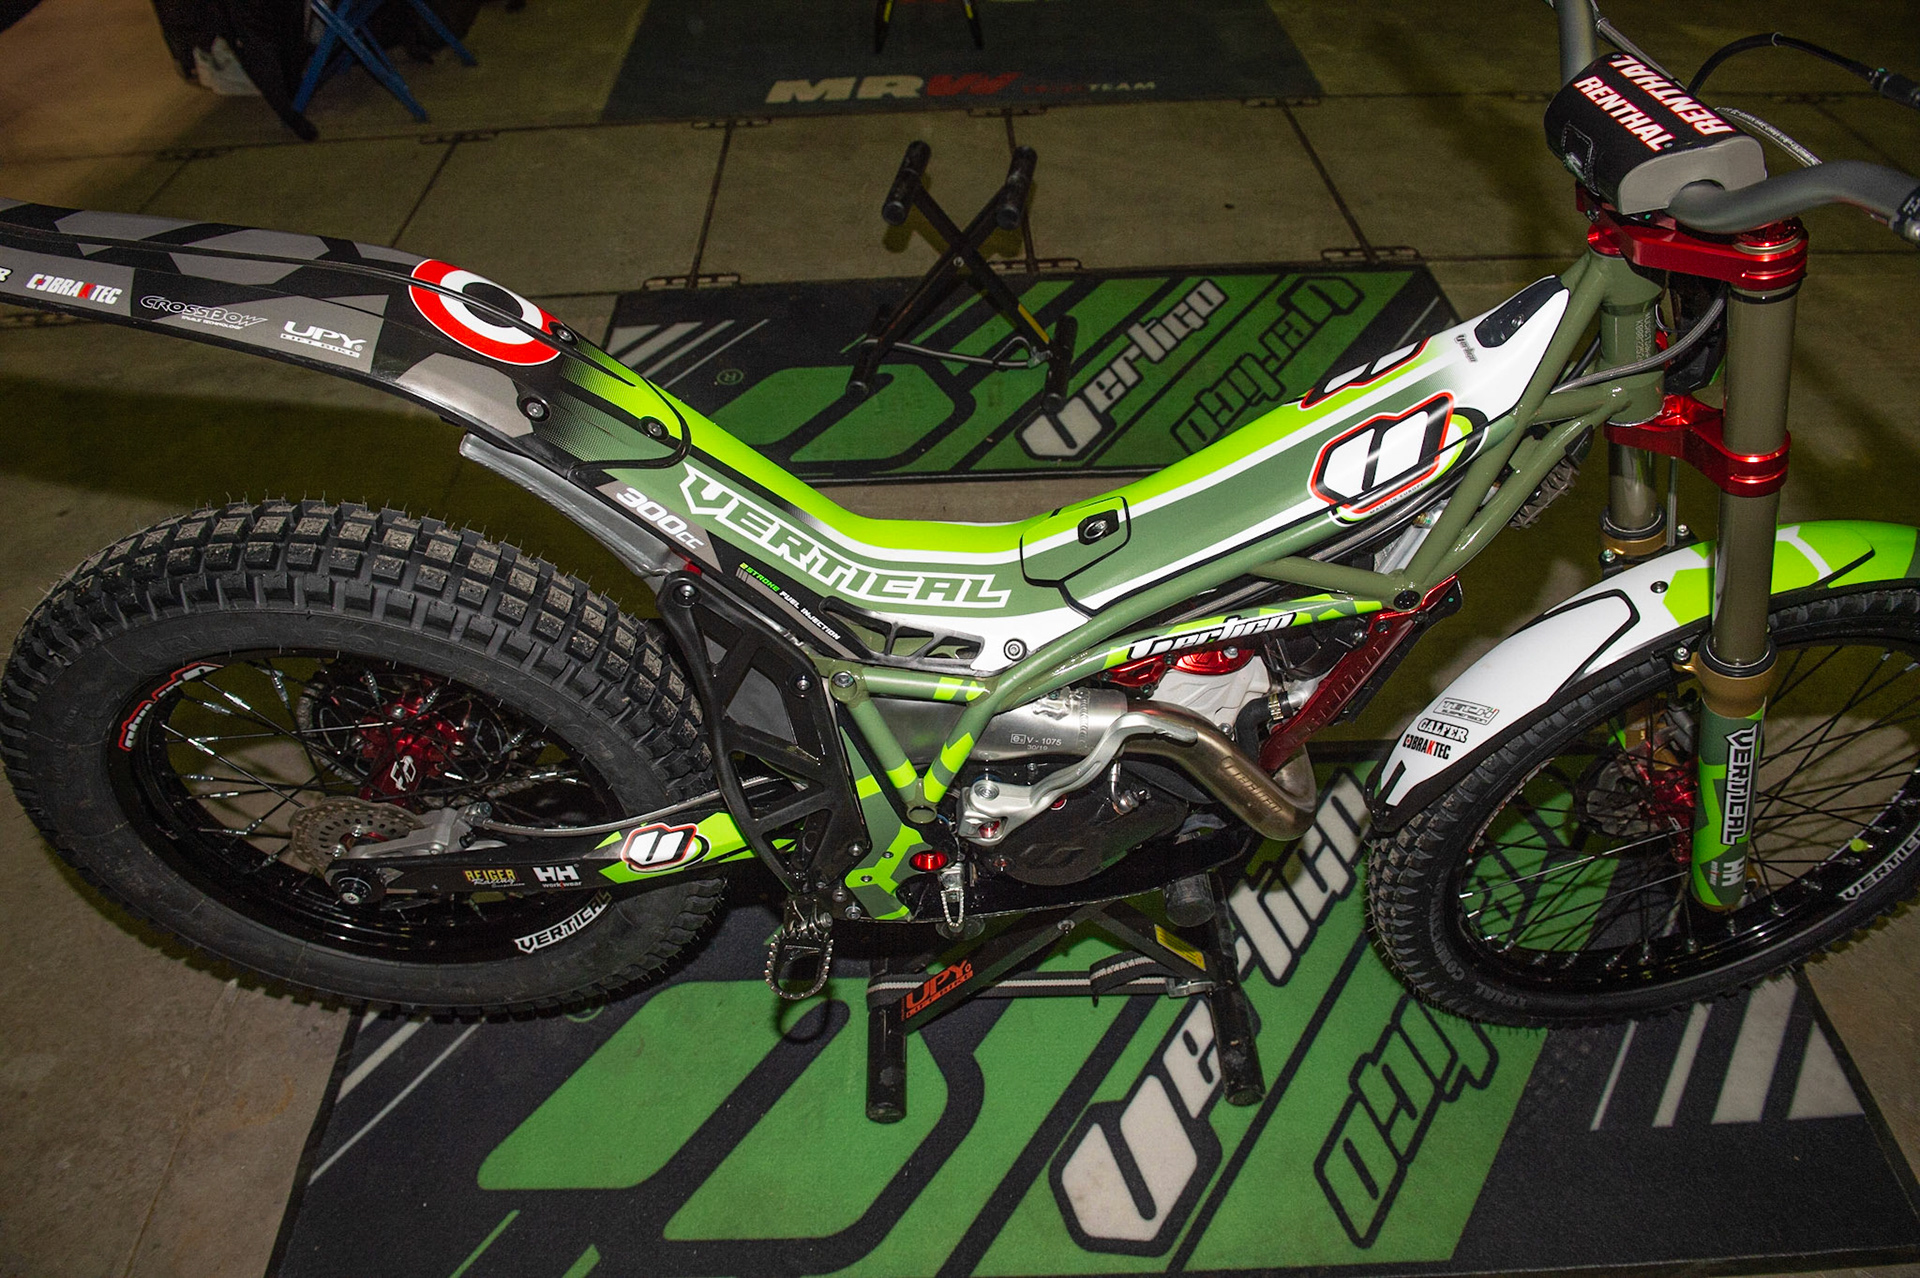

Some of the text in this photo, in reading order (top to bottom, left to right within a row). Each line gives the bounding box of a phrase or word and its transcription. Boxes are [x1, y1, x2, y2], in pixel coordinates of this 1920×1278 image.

[1573, 75, 1676, 152] RENTHAL
[1608, 54, 1736, 135] RENTHAL
[283, 320, 367, 348] UPY
[679, 461, 1011, 607] VERTICAL
[779, 590, 801, 611] FUEL
[800, 607, 841, 641] INJECTION
[1418, 718, 1469, 743] GALFER
[1722, 723, 1758, 845] VERTICAL
[532, 865, 580, 882] HH
[514, 891, 612, 953] VERTICAL
[906, 960, 968, 1009] UPY
